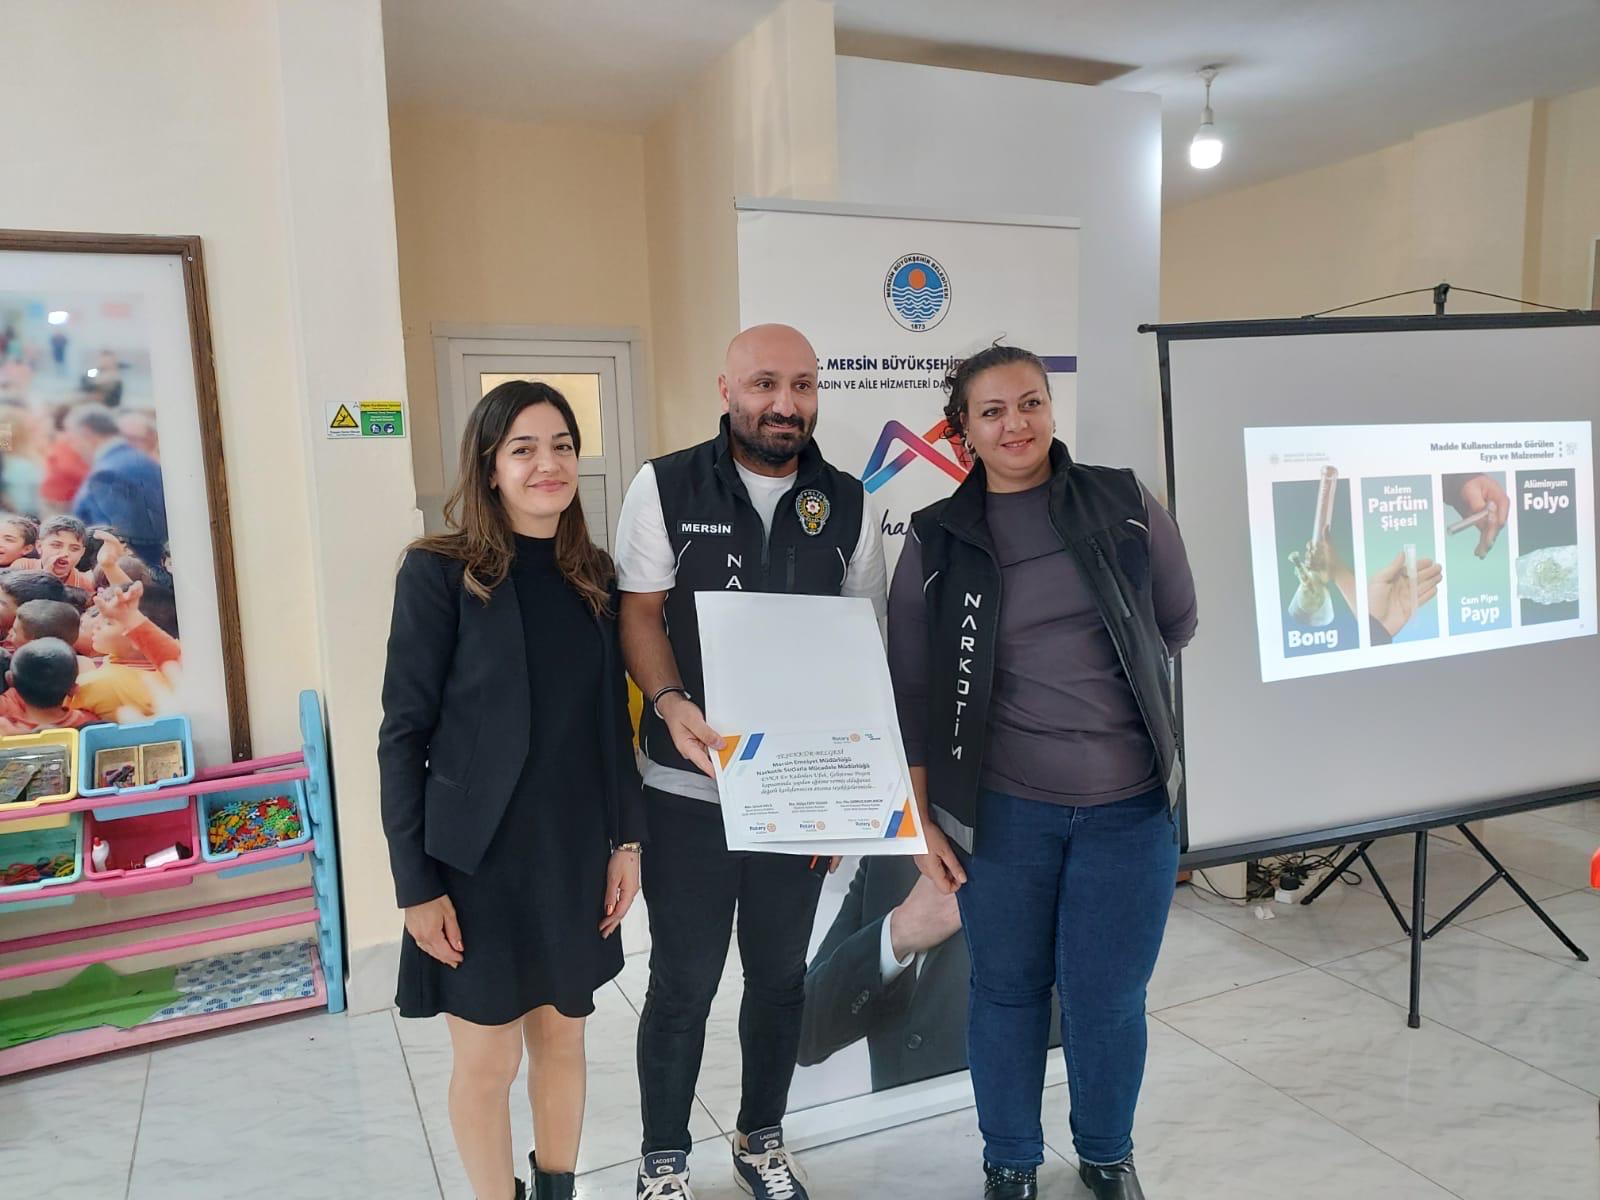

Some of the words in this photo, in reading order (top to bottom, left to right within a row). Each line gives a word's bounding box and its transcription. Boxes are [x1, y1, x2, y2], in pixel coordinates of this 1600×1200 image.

[827, 355, 877, 371] MERSİN
[818, 380, 842, 390] ADIN
[843, 380, 856, 389] VE
[858, 378, 878, 390] AİLE
[880, 378, 931, 390] HİZMETLERİ
[933, 379, 946, 389] DA
[1430, 442, 1459, 452] Madde
[1524, 439, 1554, 449] Görülen
[1511, 451, 1554, 460] Malzemeler
[1384, 486, 1412, 495] Kalem
[1523, 479, 1568, 489] Alüminyum
[1368, 495, 1429, 513] Parfüm
[1523, 490, 1570, 514] Folyo
[681, 523, 732, 534] MERSİN
[881, 509, 907, 536] ha
[1381, 513, 1418, 532] Şişesi
[725, 553, 743, 590] NA
[1461, 596, 1479, 606] Cam
[1461, 605, 1500, 625] Payp
[1287, 629, 1339, 649] Bong
[759, 1132, 780, 1141] LACOSTE
[652, 1157, 677, 1165] LACOSTE
